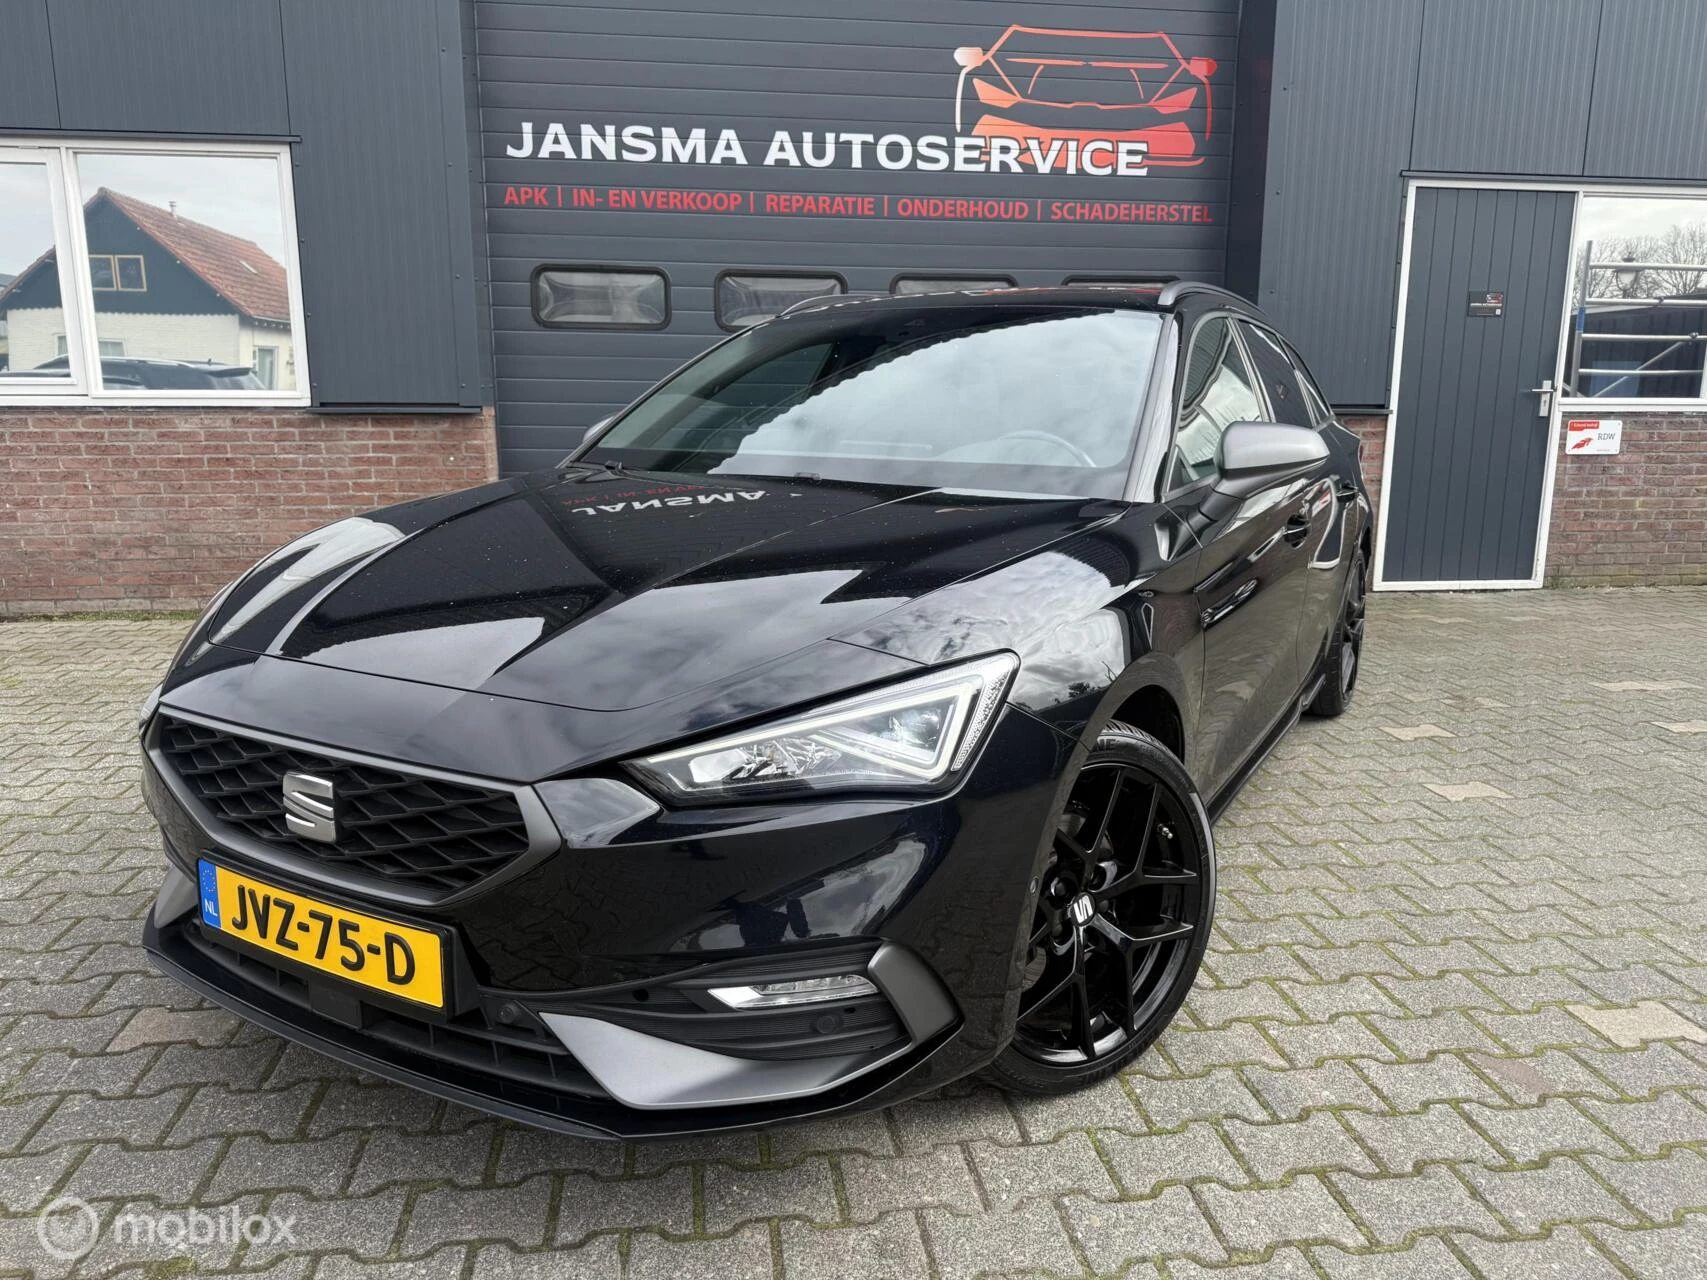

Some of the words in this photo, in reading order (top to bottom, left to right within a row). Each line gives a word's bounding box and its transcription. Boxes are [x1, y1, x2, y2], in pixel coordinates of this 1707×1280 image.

[507, 122, 747, 164] JANSMA
[764, 130, 1147, 176] AUTOSERVICE
[505, 188, 547, 205] APK
[573, 189, 602, 207] IN-
[609, 190, 636, 208] EN
[642, 191, 742, 211] VERKOOP
[766, 194, 874, 215] REPARATIE
[898, 199, 1028, 219] ONDERHOUD
[1052, 202, 1211, 222] SCHADEHERSTEL
[1597, 432, 1616, 441] RDW
[204, 899, 218, 917] NL
[231, 885, 416, 985] JVZ-75-D
